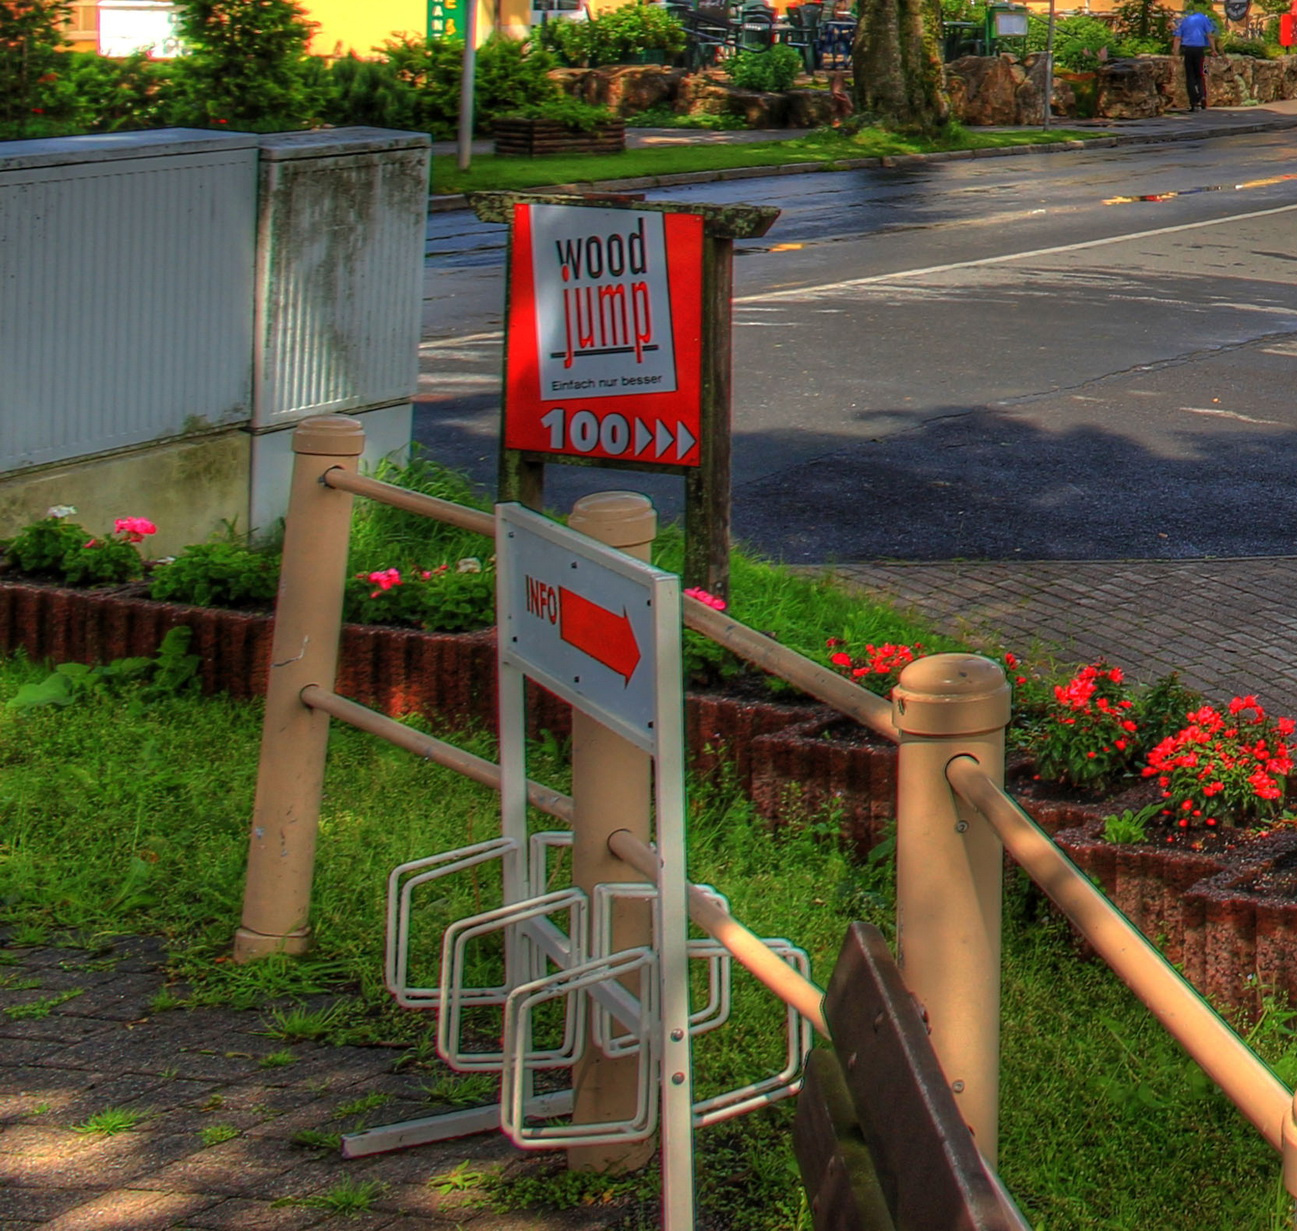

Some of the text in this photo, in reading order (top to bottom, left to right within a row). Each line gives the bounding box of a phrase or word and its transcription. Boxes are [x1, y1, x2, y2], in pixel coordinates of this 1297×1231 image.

[556, 218, 647, 280] wood
[563, 268, 652, 369] jump
[551, 374, 663, 392] Einfach nur besser
[540, 408, 630, 455] 100
[525, 574, 557, 625] INFO
